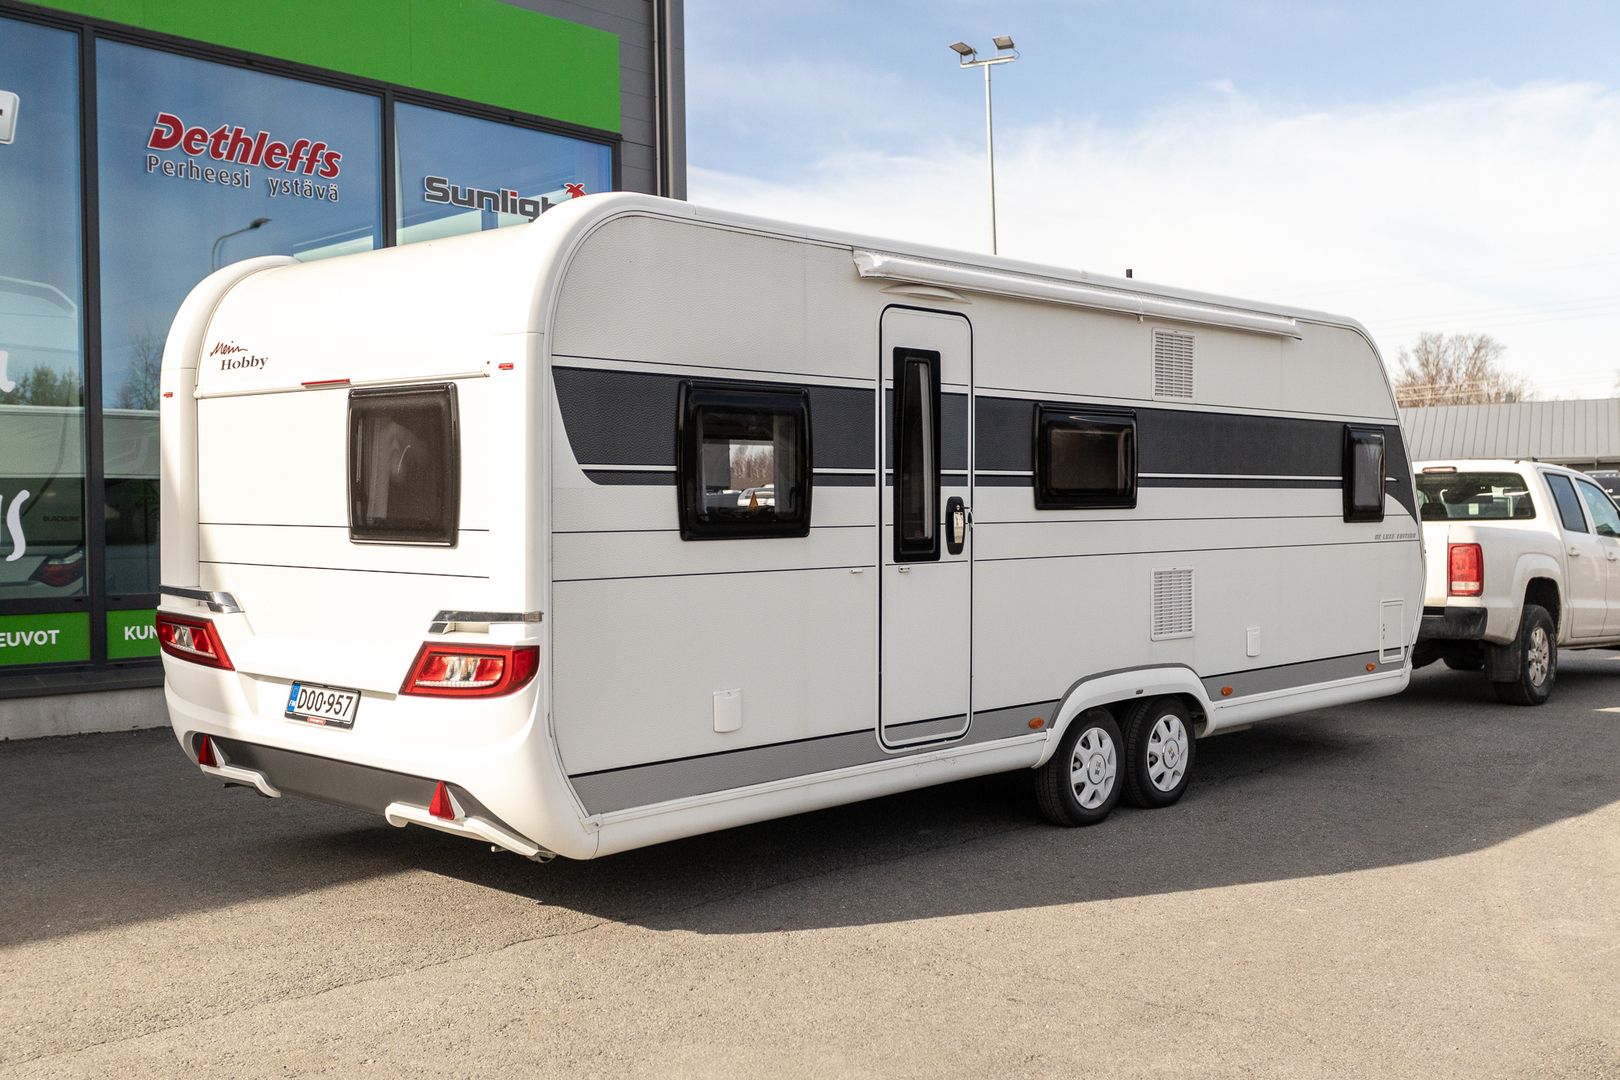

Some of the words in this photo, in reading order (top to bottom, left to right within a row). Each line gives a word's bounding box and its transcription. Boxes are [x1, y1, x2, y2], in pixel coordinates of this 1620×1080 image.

[147, 111, 342, 179] Dethleffs
[146, 154, 251, 190] Perheesi
[268, 175, 340, 202] ystävä
[424, 175, 557, 223] Sunligh
[220, 355, 269, 371] Hobby
[0, 630, 60, 648] EUVOT
[124, 625, 158, 641] KUN
